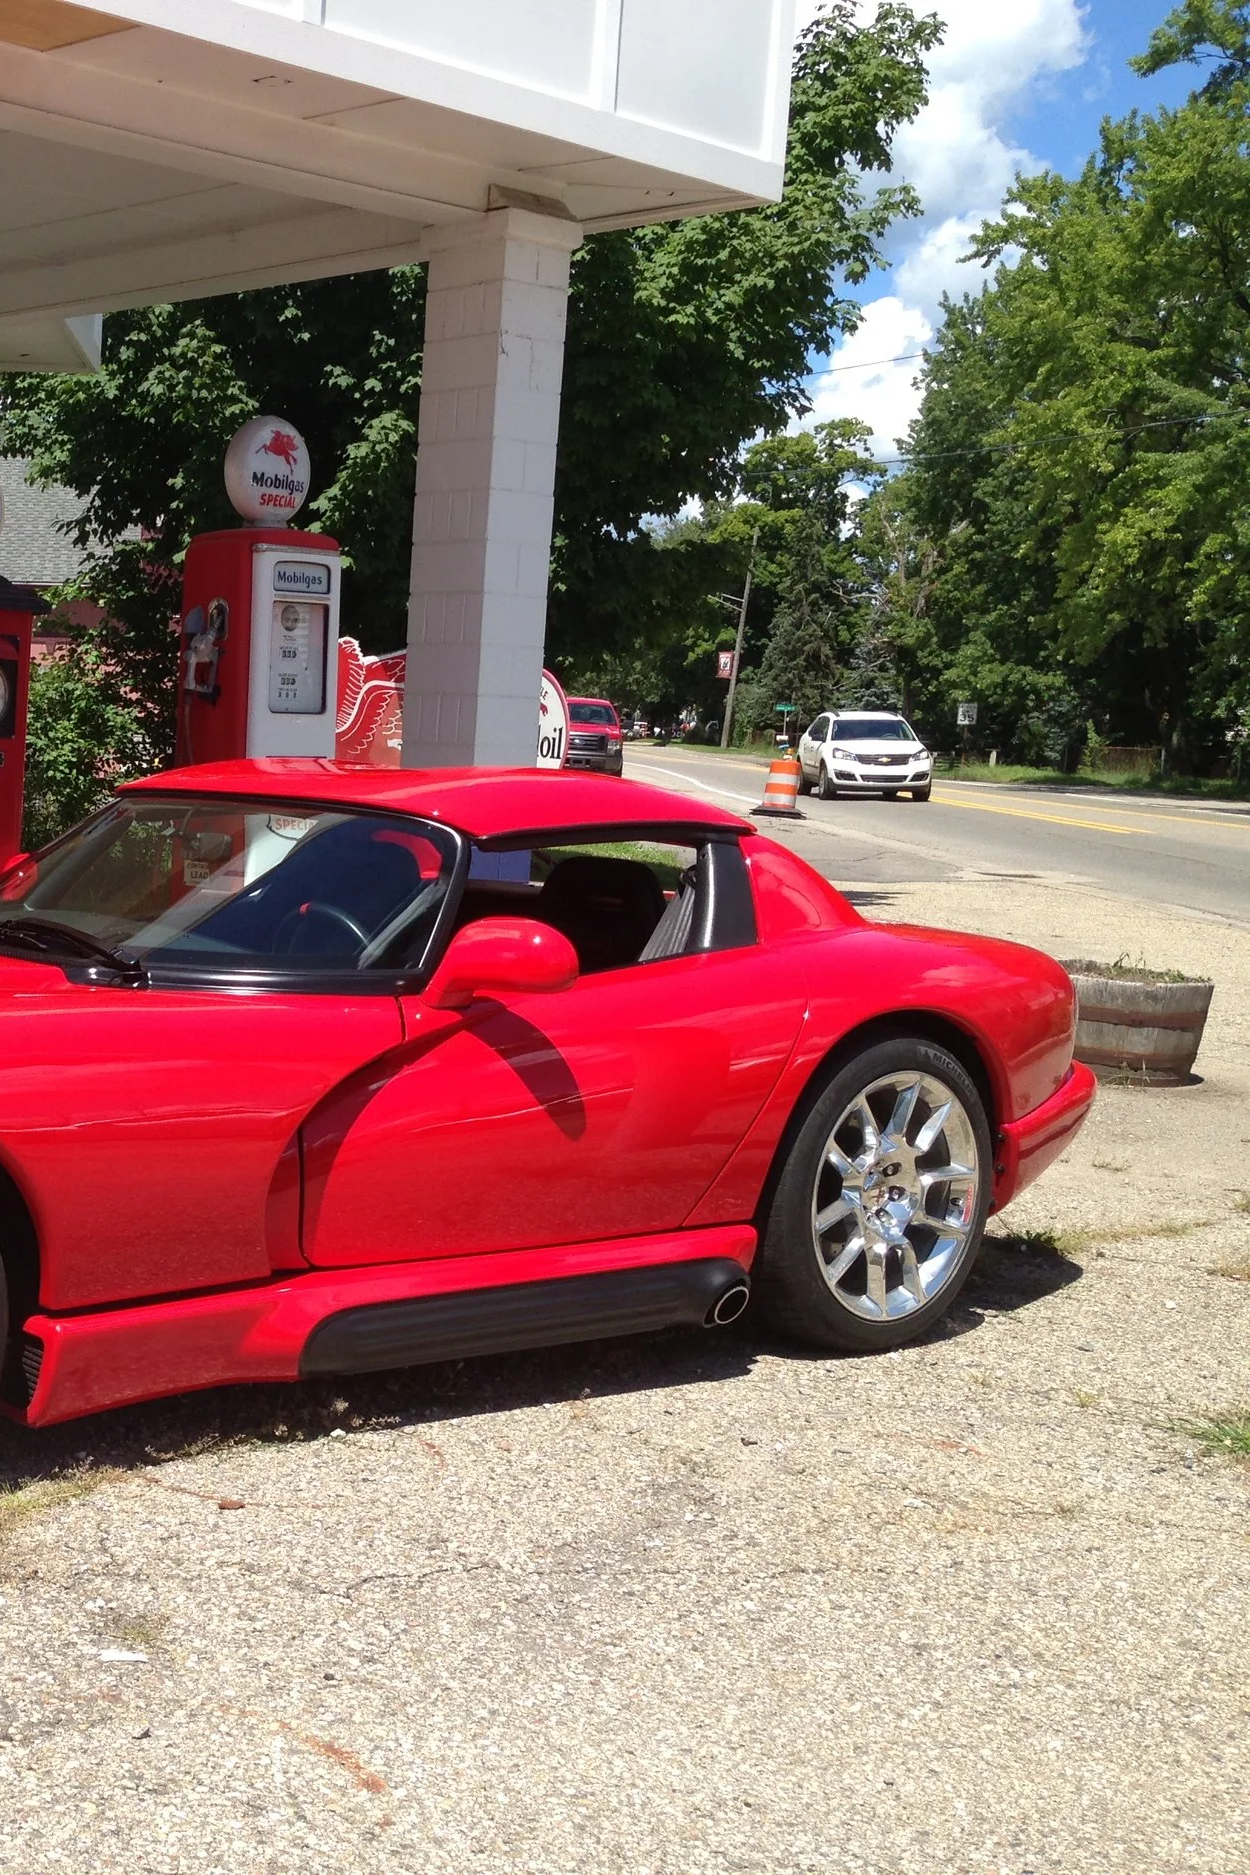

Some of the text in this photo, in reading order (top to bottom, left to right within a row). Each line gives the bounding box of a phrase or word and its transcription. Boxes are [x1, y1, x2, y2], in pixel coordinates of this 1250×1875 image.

[252, 471, 305, 496] Mobilgas
[259, 493, 296, 509] SPECIAL
[277, 570, 323, 589] Mobilgas
[959, 713, 975, 722] 35
[190, 870, 209, 880] LEAD
